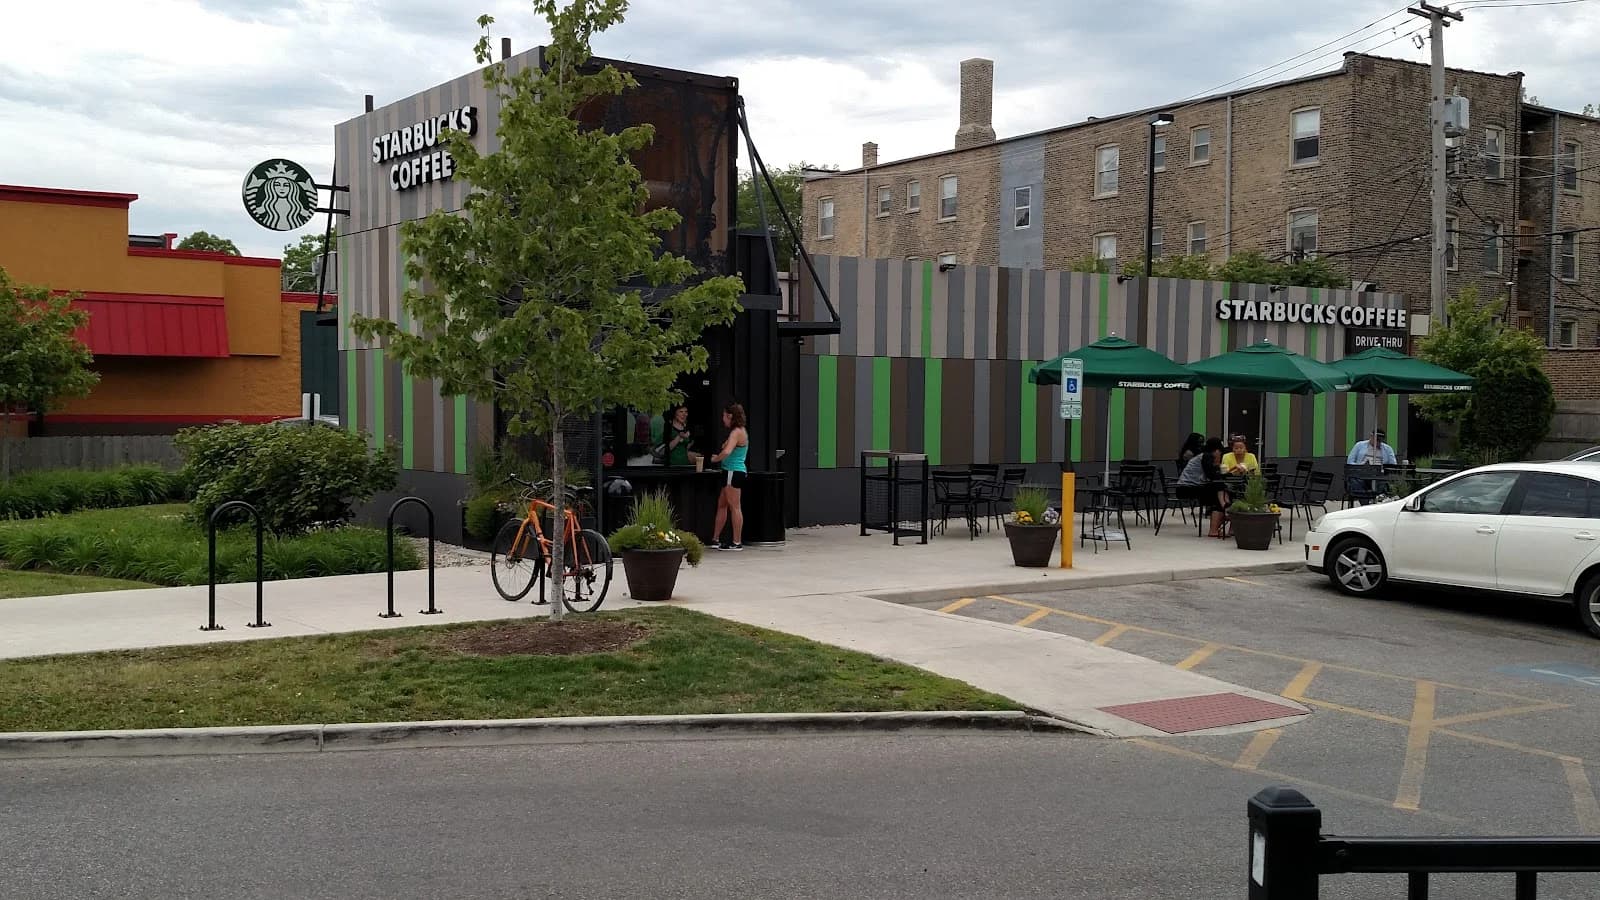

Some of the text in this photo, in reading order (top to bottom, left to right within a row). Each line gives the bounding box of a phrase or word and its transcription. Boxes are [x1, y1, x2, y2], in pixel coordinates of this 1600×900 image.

[372, 105, 474, 164] STARBUCKS
[389, 149, 453, 191] COFFEE
[1218, 299, 1407, 328] STARBUCKS COFFEE
[1355, 335, 1403, 348] DRIVE THRU
[1117, 381, 1162, 389] STARBUCKS
